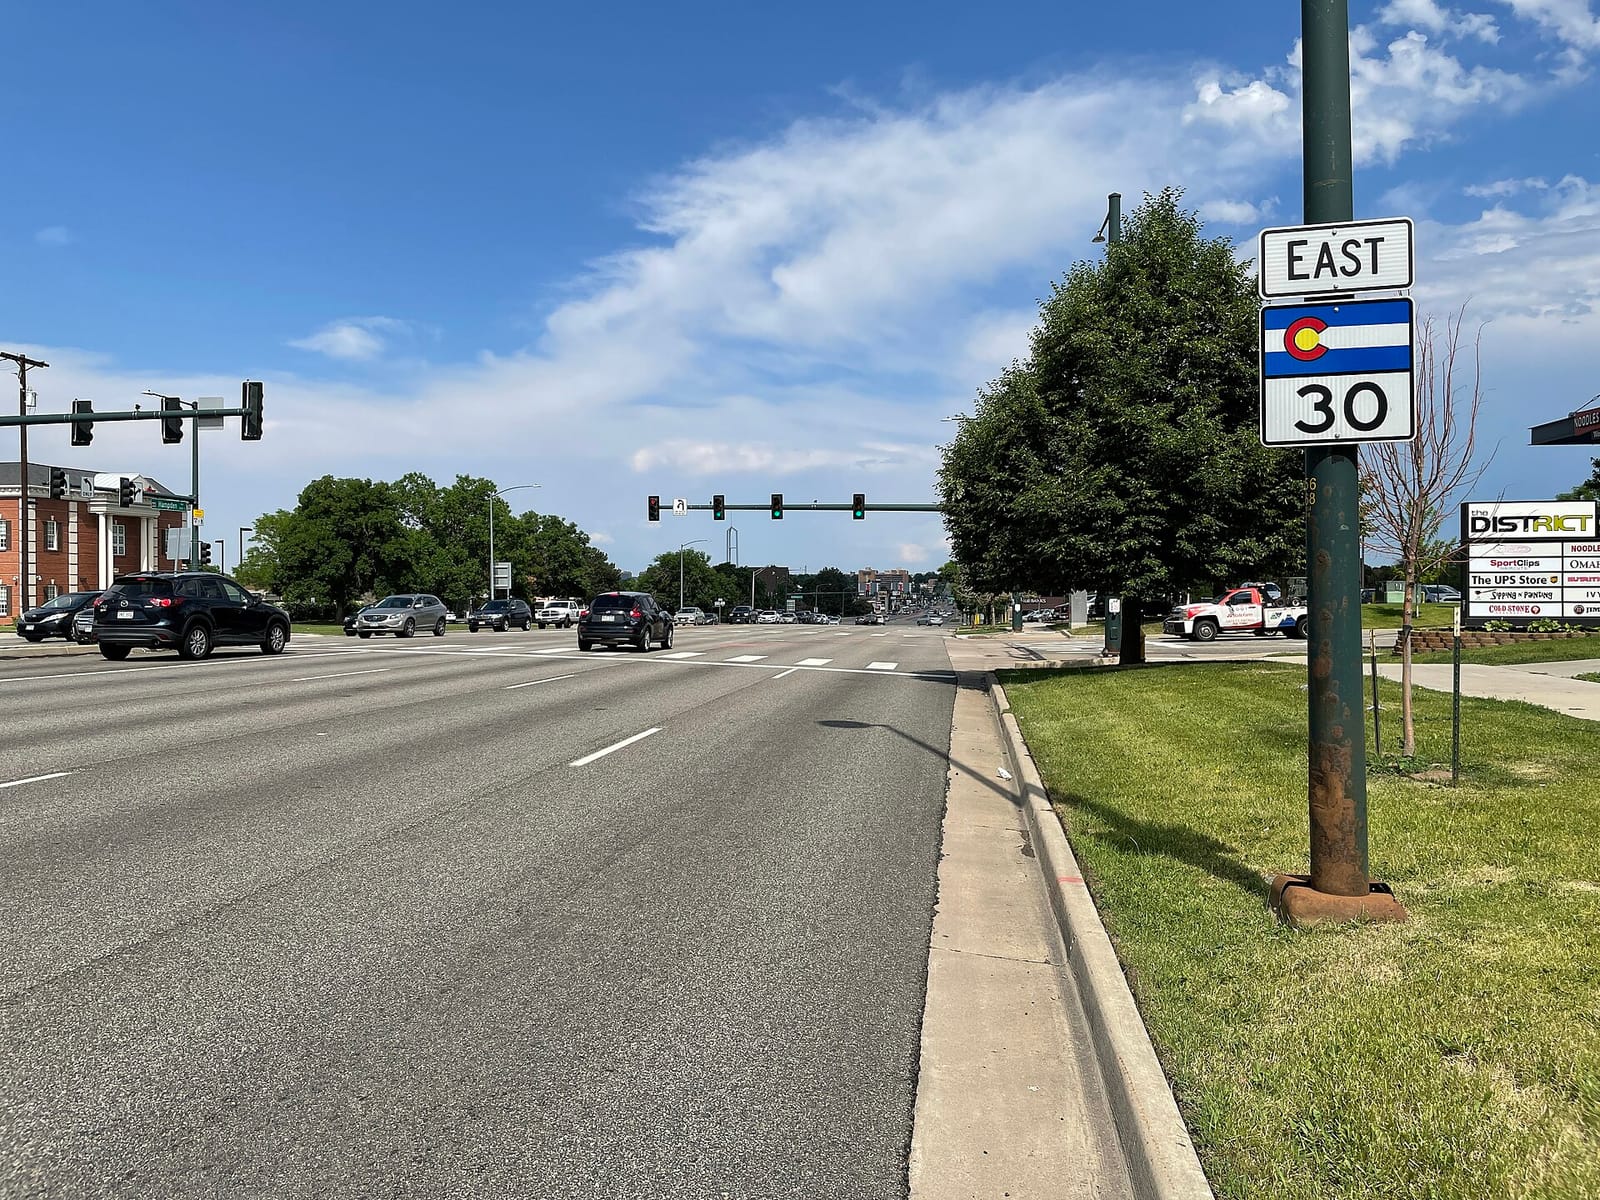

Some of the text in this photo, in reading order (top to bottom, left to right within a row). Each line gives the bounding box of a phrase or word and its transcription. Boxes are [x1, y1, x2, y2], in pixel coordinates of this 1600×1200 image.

[1287, 237, 1385, 281] EAST
[1294, 381, 1388, 434] 30
[1471, 514, 1593, 533] DISTRICT
[1490, 559, 1540, 568] SportClips
[1472, 575, 1547, 585] The UPS Store
[1489, 604, 1507, 613] COLD
[1507, 604, 1530, 613] STONE
